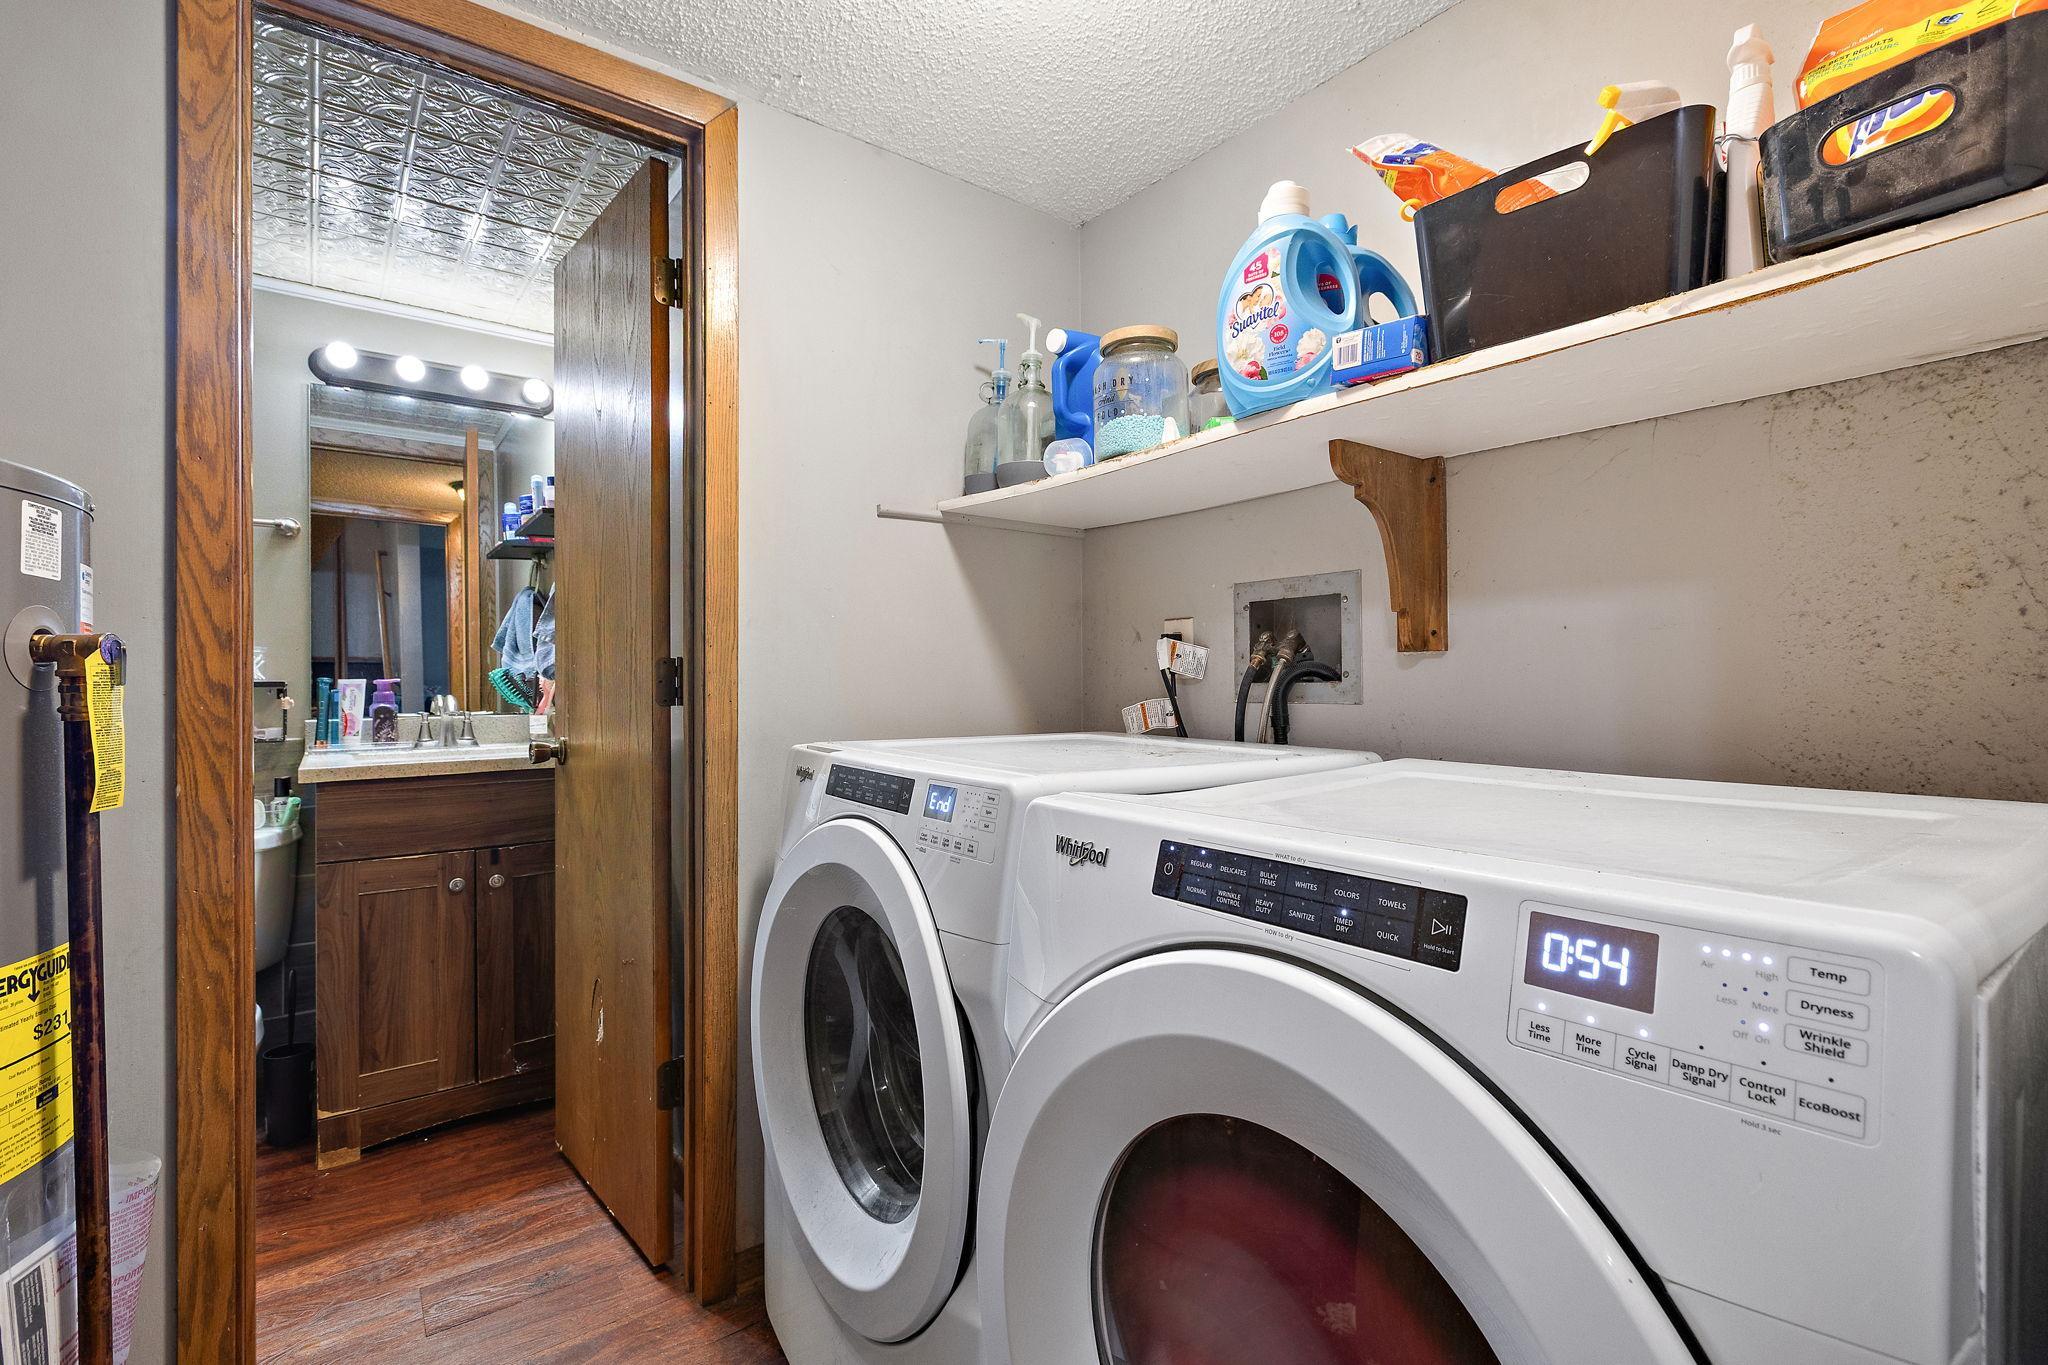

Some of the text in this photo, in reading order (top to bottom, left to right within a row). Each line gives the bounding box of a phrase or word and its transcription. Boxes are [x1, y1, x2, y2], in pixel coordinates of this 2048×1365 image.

[1828, 53, 1851, 66] BEST
[1852, 37, 1894, 56] RESULTS
[1249, 260, 1263, 272] 45
[1231, 301, 1280, 338] Suavitel
[1112, 375, 1134, 388] DRY
[1097, 407, 1119, 422] FOLD
[929, 792, 952, 813] End
[1056, 834, 1109, 867] Whirlpool
[1190, 859, 1213, 869] REGULAR
[1297, 856, 1307, 864] dry
[1220, 865, 1247, 876] DELICATES
[1260, 870, 1279, 880] BULKY
[1259, 879, 1276, 887] ITEMS
[1295, 881, 1318, 891] WHITES
[1186, 886, 1207, 896] NORMAL
[1218, 890, 1241, 900] WRINKLE
[1334, 889, 1360, 900] COLORS
[1216, 896, 1240, 907] CONTROL
[1255, 898, 1274, 908] HEAVY
[1378, 898, 1407, 910] TOWELS
[1255, 906, 1272, 915] DUTY
[1289, 909, 1315, 922] SANITIZE
[1333, 916, 1354, 926] TIMED
[1264, 927, 1279, 937] HOW
[1286, 932, 1294, 941] dry
[1335, 924, 1350, 934] DRY
[1376, 930, 1400, 942] QUICK
[1423, 942, 1435, 951] Hold
[1441, 946, 1455, 955] Start
[1542, 931, 1630, 986] 0:54
[1701, 960, 1714, 969] Air
[1755, 970, 1779, 982] High
[1809, 967, 1847, 984] Temp
[1716, 994, 1738, 1005] Less
[1752, 1001, 1779, 1014] More
[1800, 1000, 1855, 1020] Dryness
[20, 1013, 35, 1024] Yearly
[33, 1010, 69, 1041] $231
[1530, 1021, 1550, 1033] Less
[1528, 1029, 1551, 1043] Time
[1576, 1033, 1602, 1047] More
[1733, 1029, 1749, 1041] Off
[1755, 1035, 1770, 1045] On
[1799, 1029, 1851, 1050] Wrinkle
[1576, 1043, 1601, 1057] Time
[1628, 1047, 1656, 1062] Cycle
[1804, 1042, 1845, 1059] Shield
[1625, 1056, 1657, 1073] Signal
[1672, 1058, 1729, 1083] Damp Dry
[1682, 1072, 1716, 1089] Signal
[1739, 1077, 1786, 1097] Control
[1748, 1090, 1777, 1106] Lock
[1798, 1097, 1861, 1122] EcoBoost
[1740, 1118, 1760, 1129] Hold
[1768, 1127, 1782, 1136] sec
